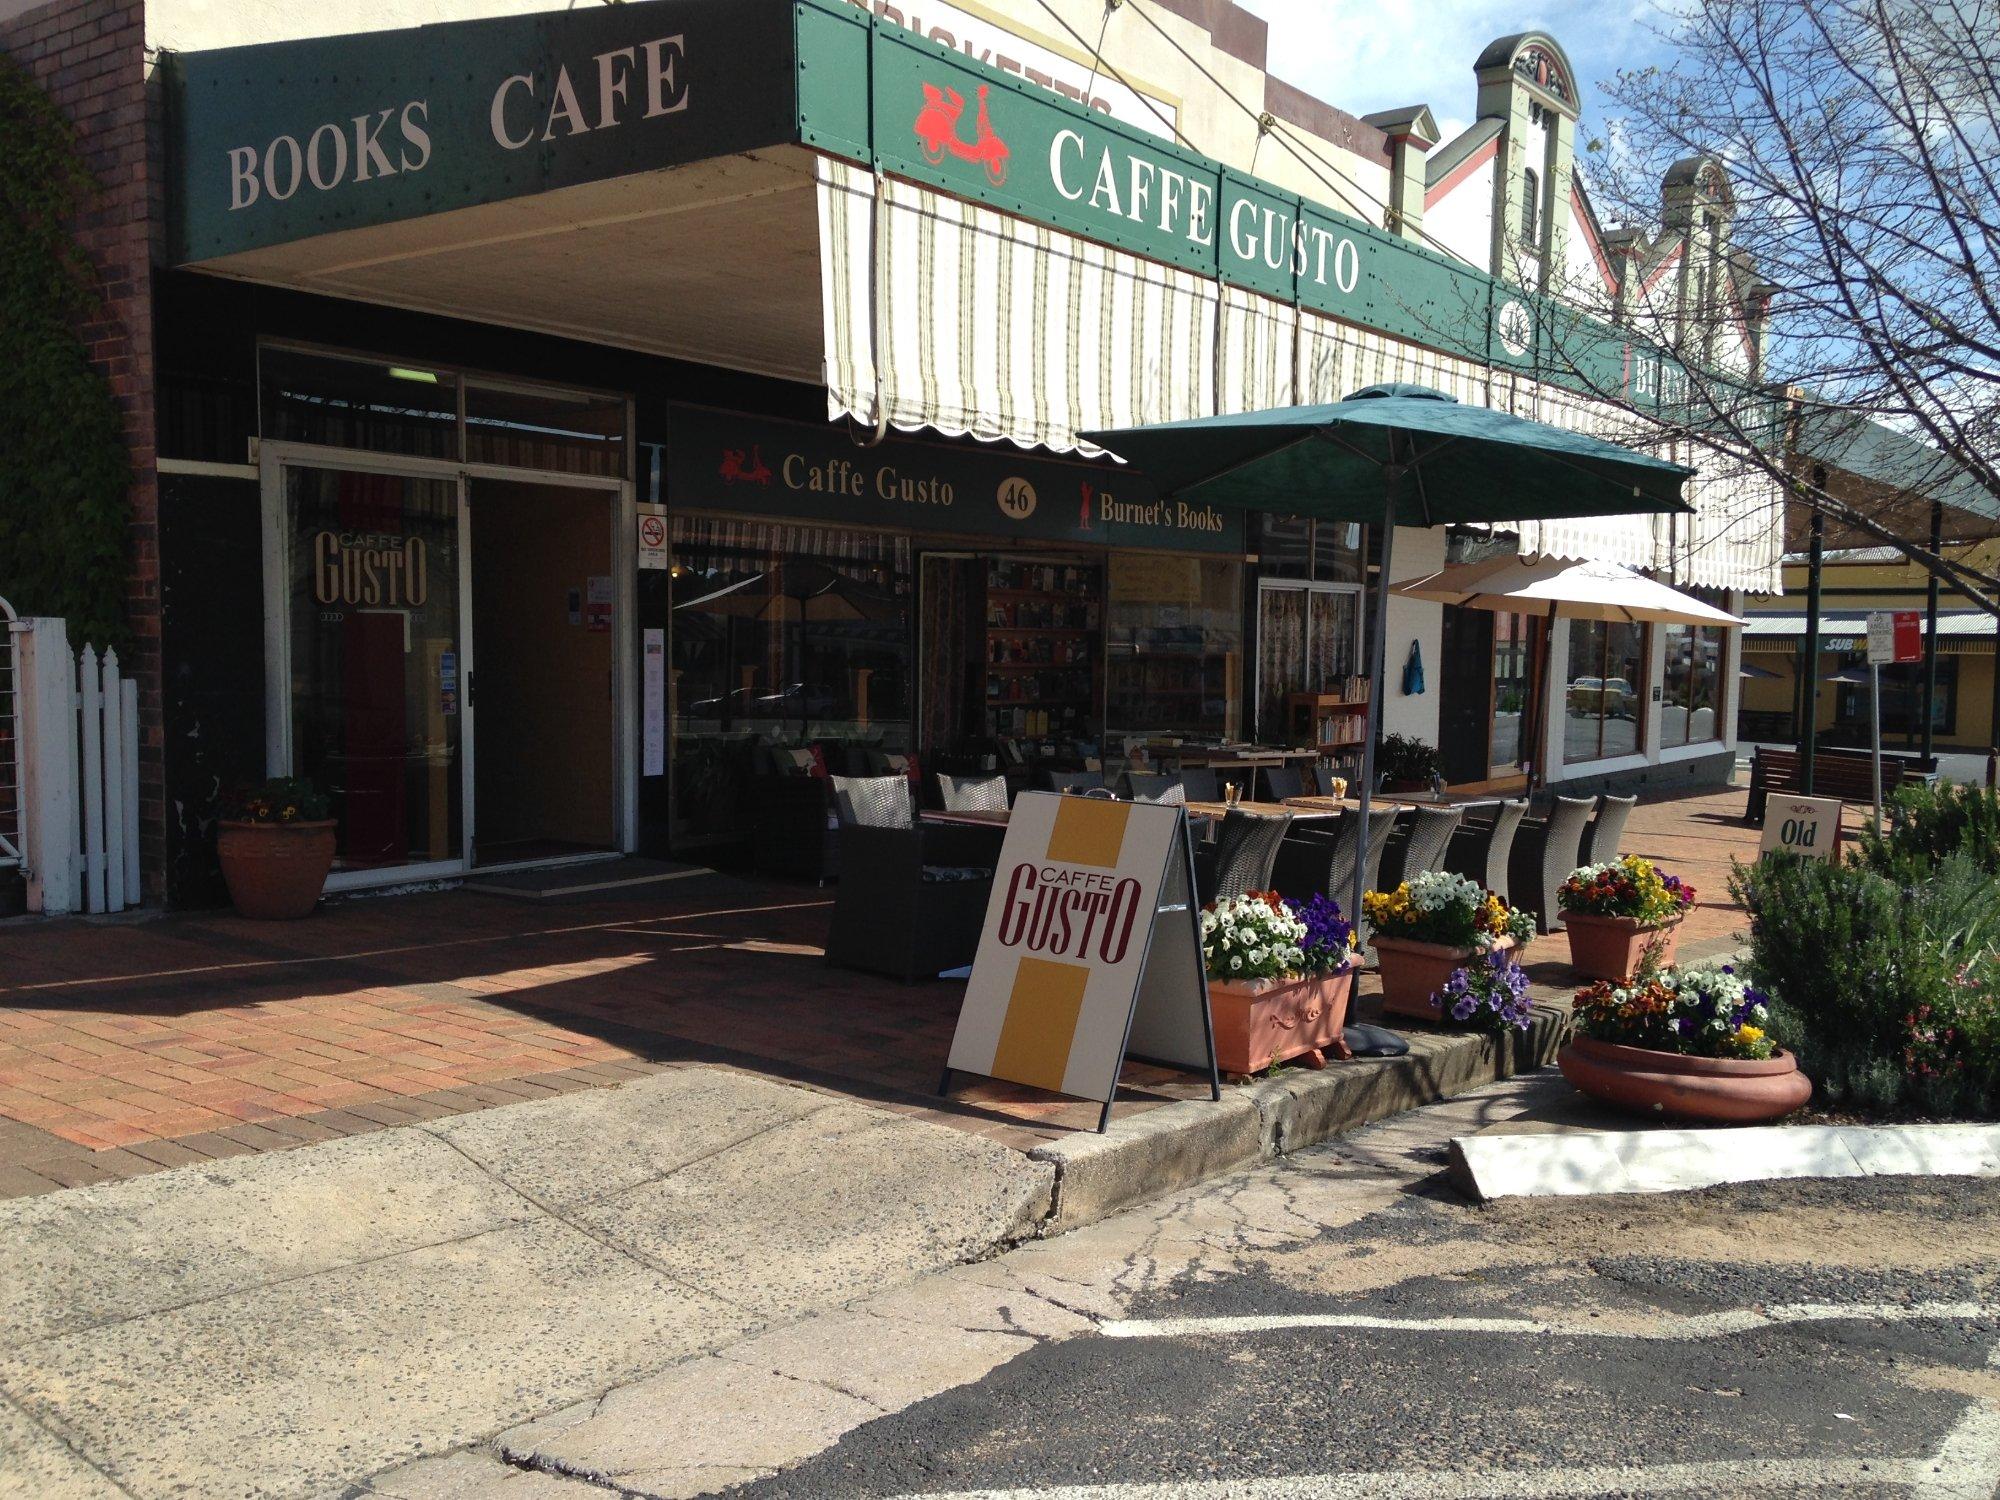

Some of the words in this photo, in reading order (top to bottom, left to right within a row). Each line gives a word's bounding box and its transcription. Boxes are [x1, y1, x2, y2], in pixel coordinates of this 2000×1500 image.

[227, 100, 431, 211] BOOKS
[490, 34, 690, 149] CAFE
[1050, 129, 1213, 246] CAFFE
[1229, 199, 1359, 293] GUSTO
[782, 454, 864, 496] Caffe
[876, 467, 954, 506] Gusto
[1005, 484, 1029, 511] 46
[1100, 493, 1172, 527] Burnet's
[1177, 501, 1223, 532] Books
[340, 533, 402, 549] CAFFE
[315, 531, 427, 606] GUSTO
[1825, 638, 1867, 651] SUBW
[1781, 819, 1817, 847] Old
[1040, 867, 1115, 891] CAFFE
[998, 863, 1142, 964] GUSTO
